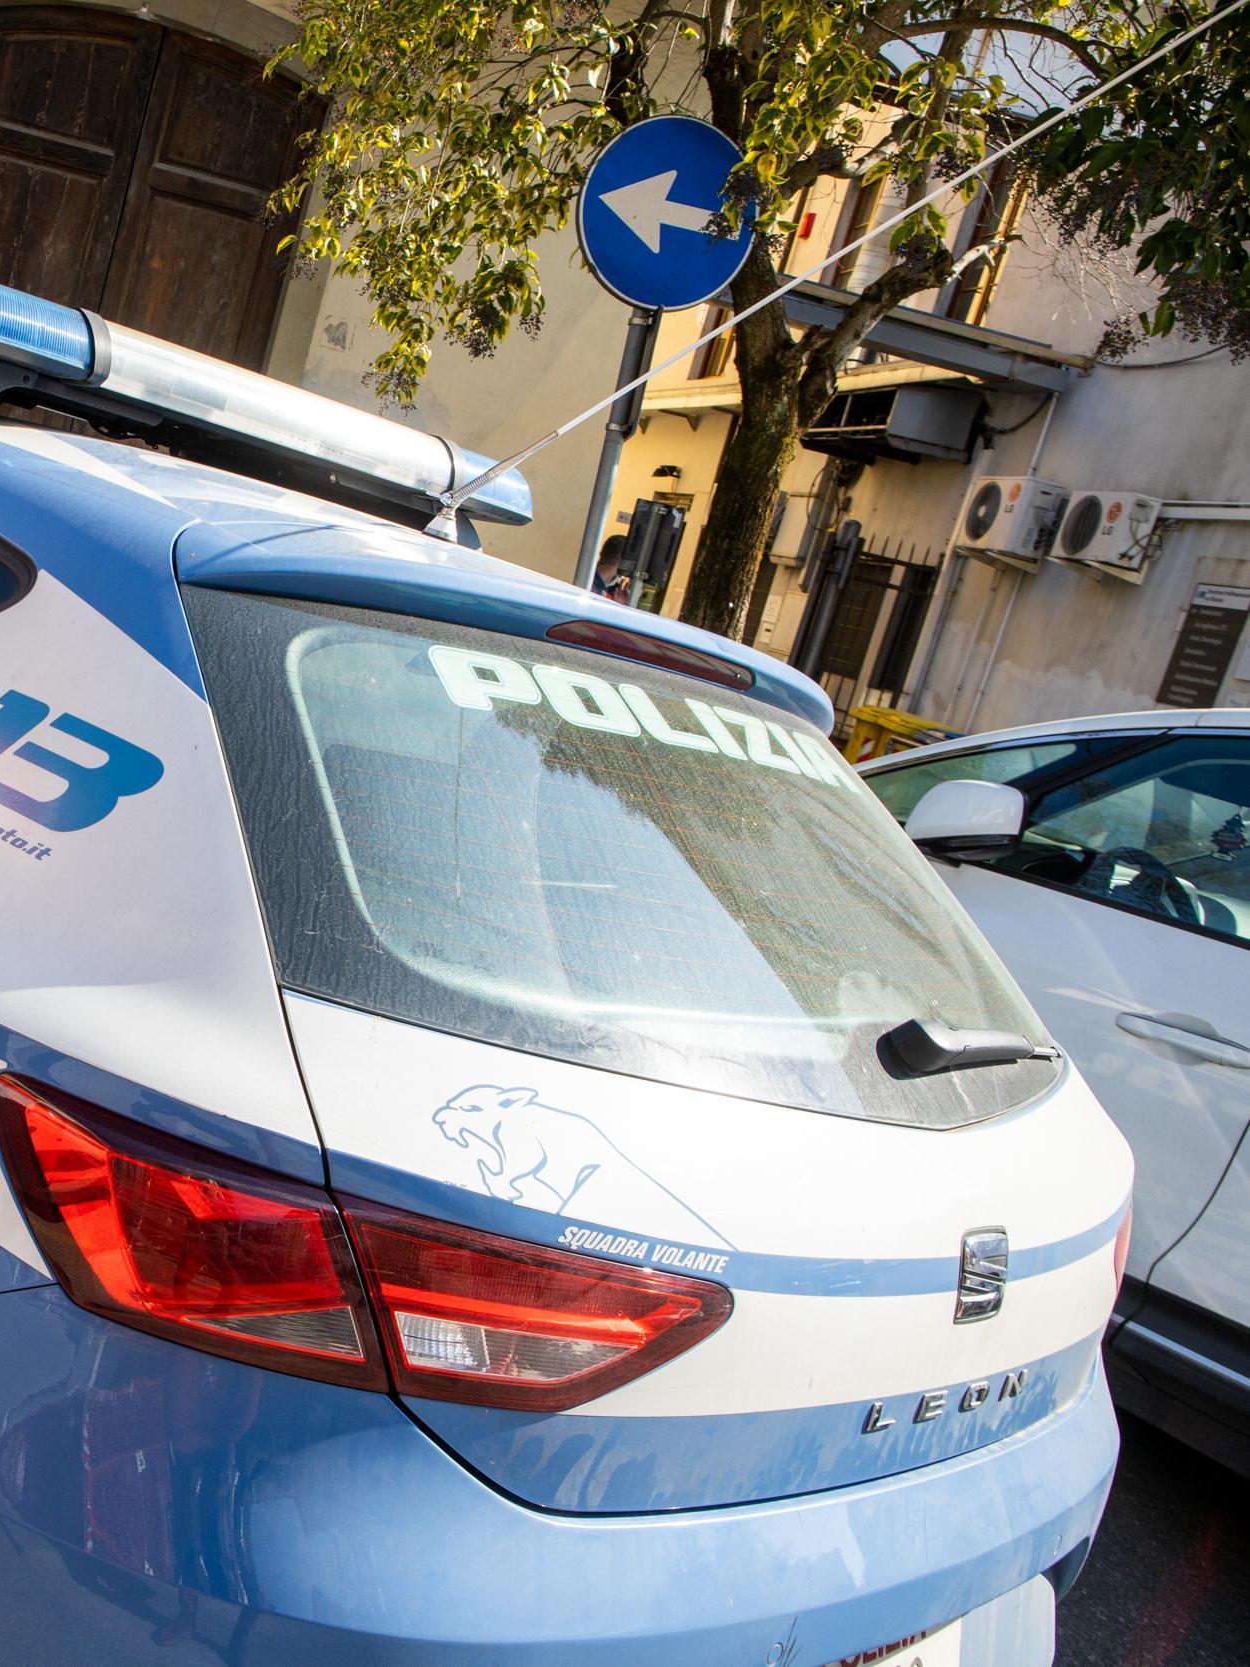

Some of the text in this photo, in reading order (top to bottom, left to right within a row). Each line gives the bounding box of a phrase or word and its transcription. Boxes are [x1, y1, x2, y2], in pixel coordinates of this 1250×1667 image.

[427, 643, 861, 794] POLIZIA
[557, 1225, 729, 1274] SQUADRA VOLANTE
[861, 1368, 1028, 1434] LEON
